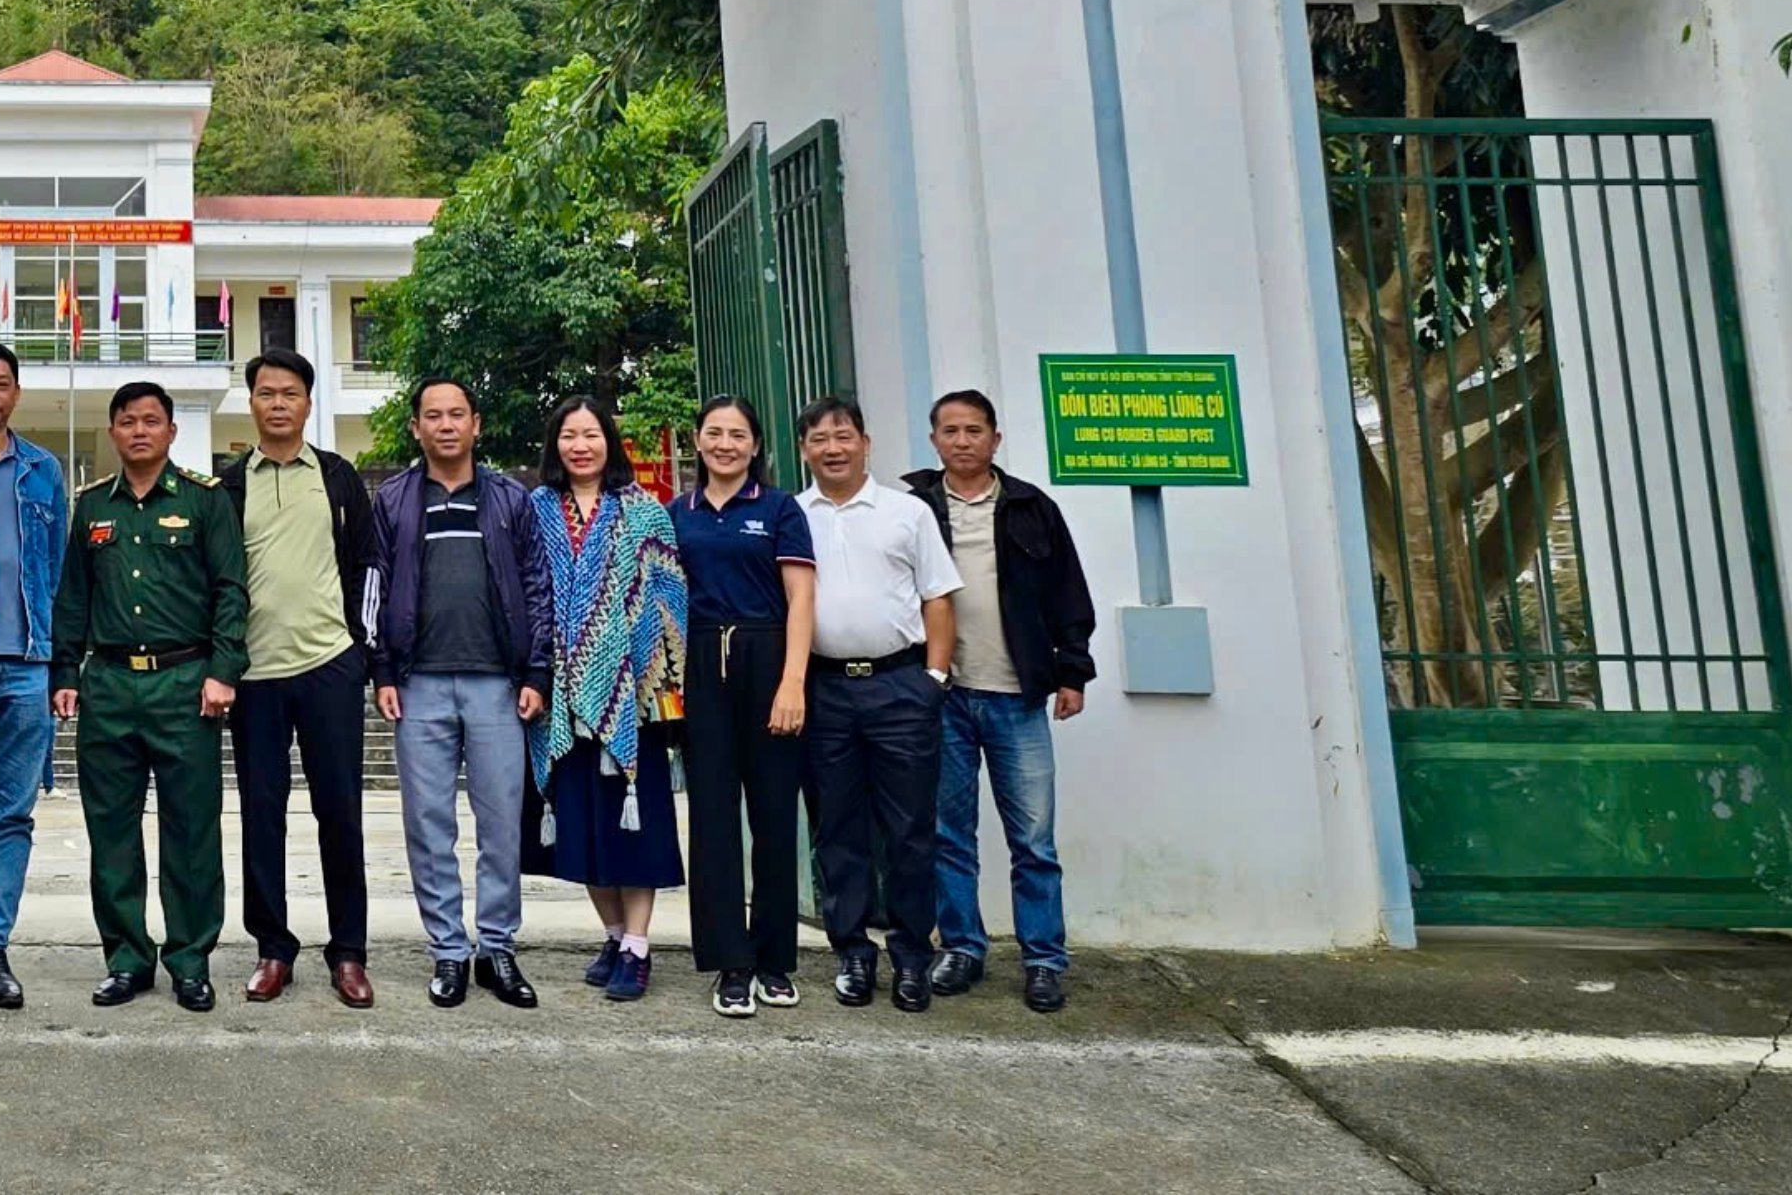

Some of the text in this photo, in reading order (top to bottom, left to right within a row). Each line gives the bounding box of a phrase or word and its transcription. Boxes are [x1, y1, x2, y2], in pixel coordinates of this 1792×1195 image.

[1089, 389, 1119, 417] BIÊN
[1123, 389, 1168, 417] PHÒNG
[1169, 390, 1205, 418] LŨNG
[1206, 390, 1225, 418] CÚ
[1074, 427, 1215, 443] LUNG CU BORDER GUARD POST
